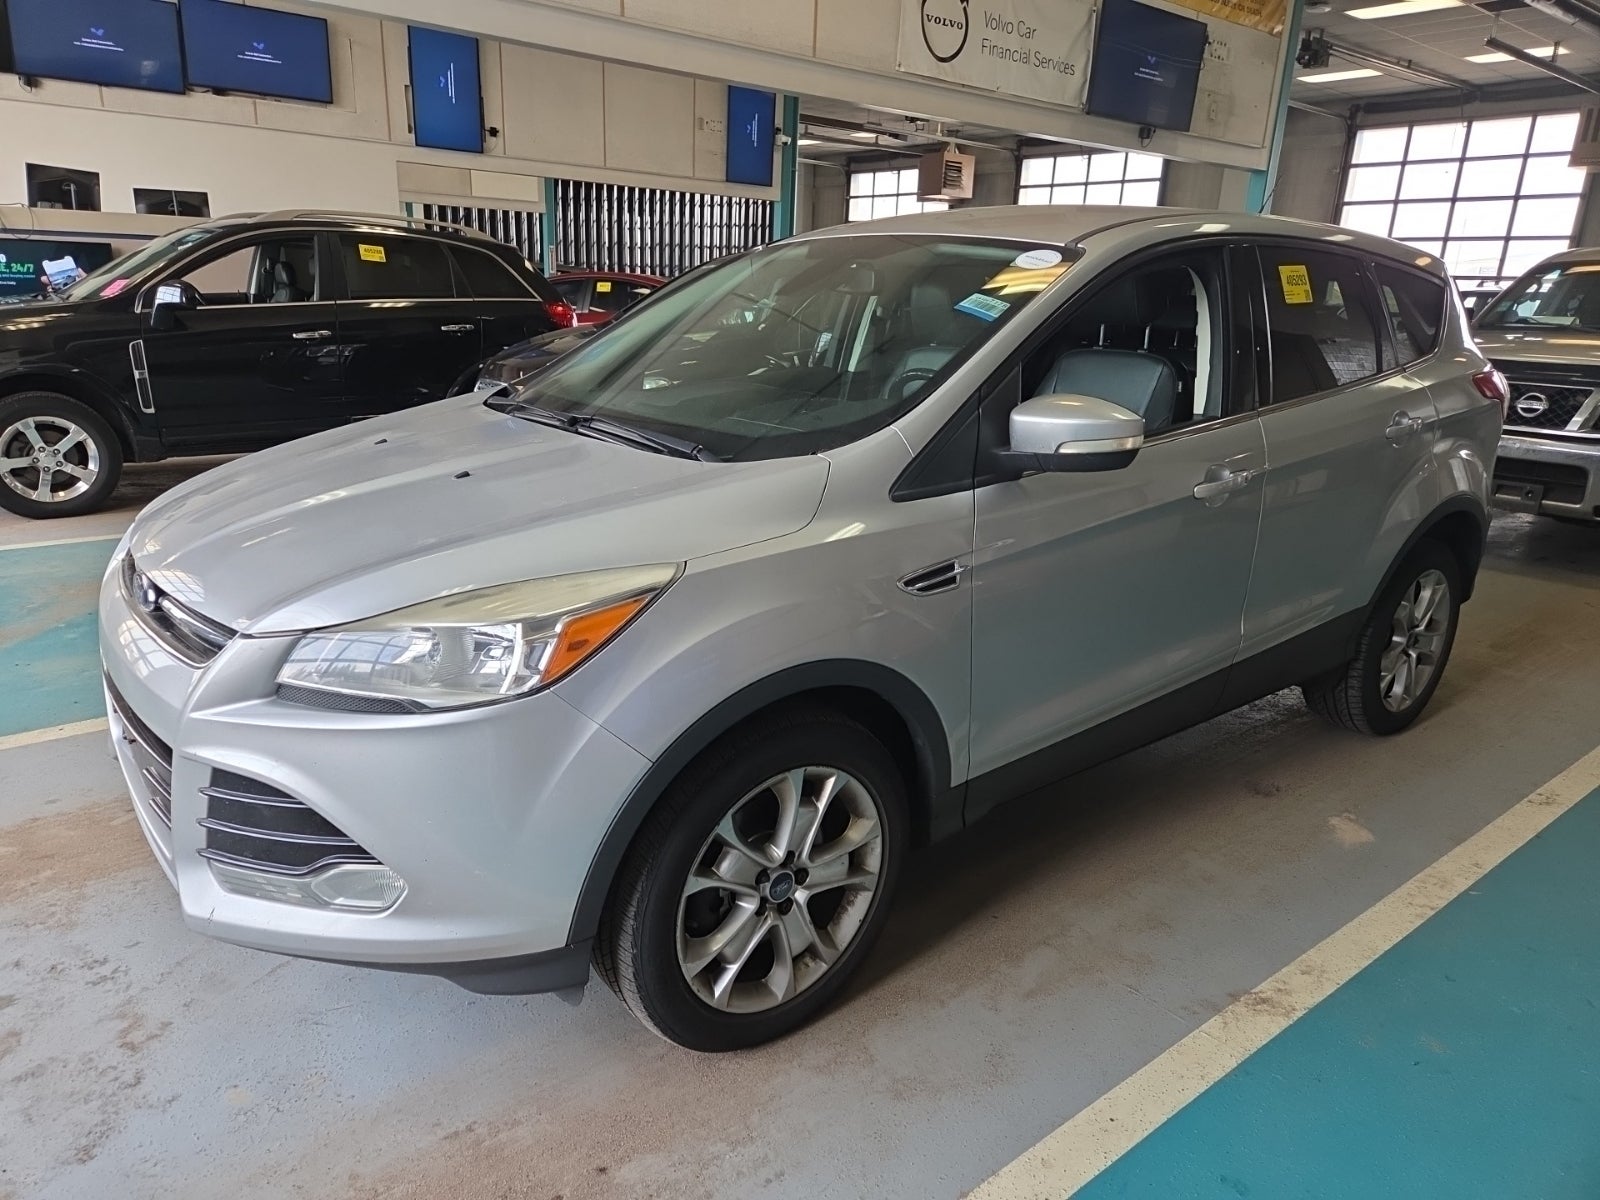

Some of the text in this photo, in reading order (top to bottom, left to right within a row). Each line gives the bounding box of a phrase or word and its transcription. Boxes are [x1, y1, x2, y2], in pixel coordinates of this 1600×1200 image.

[925, 13, 964, 31] VOLVO
[983, 10, 1037, 40] Volvo Car
[981, 37, 1076, 76] Financial Services
[11, 264, 34, 272] 24/7
